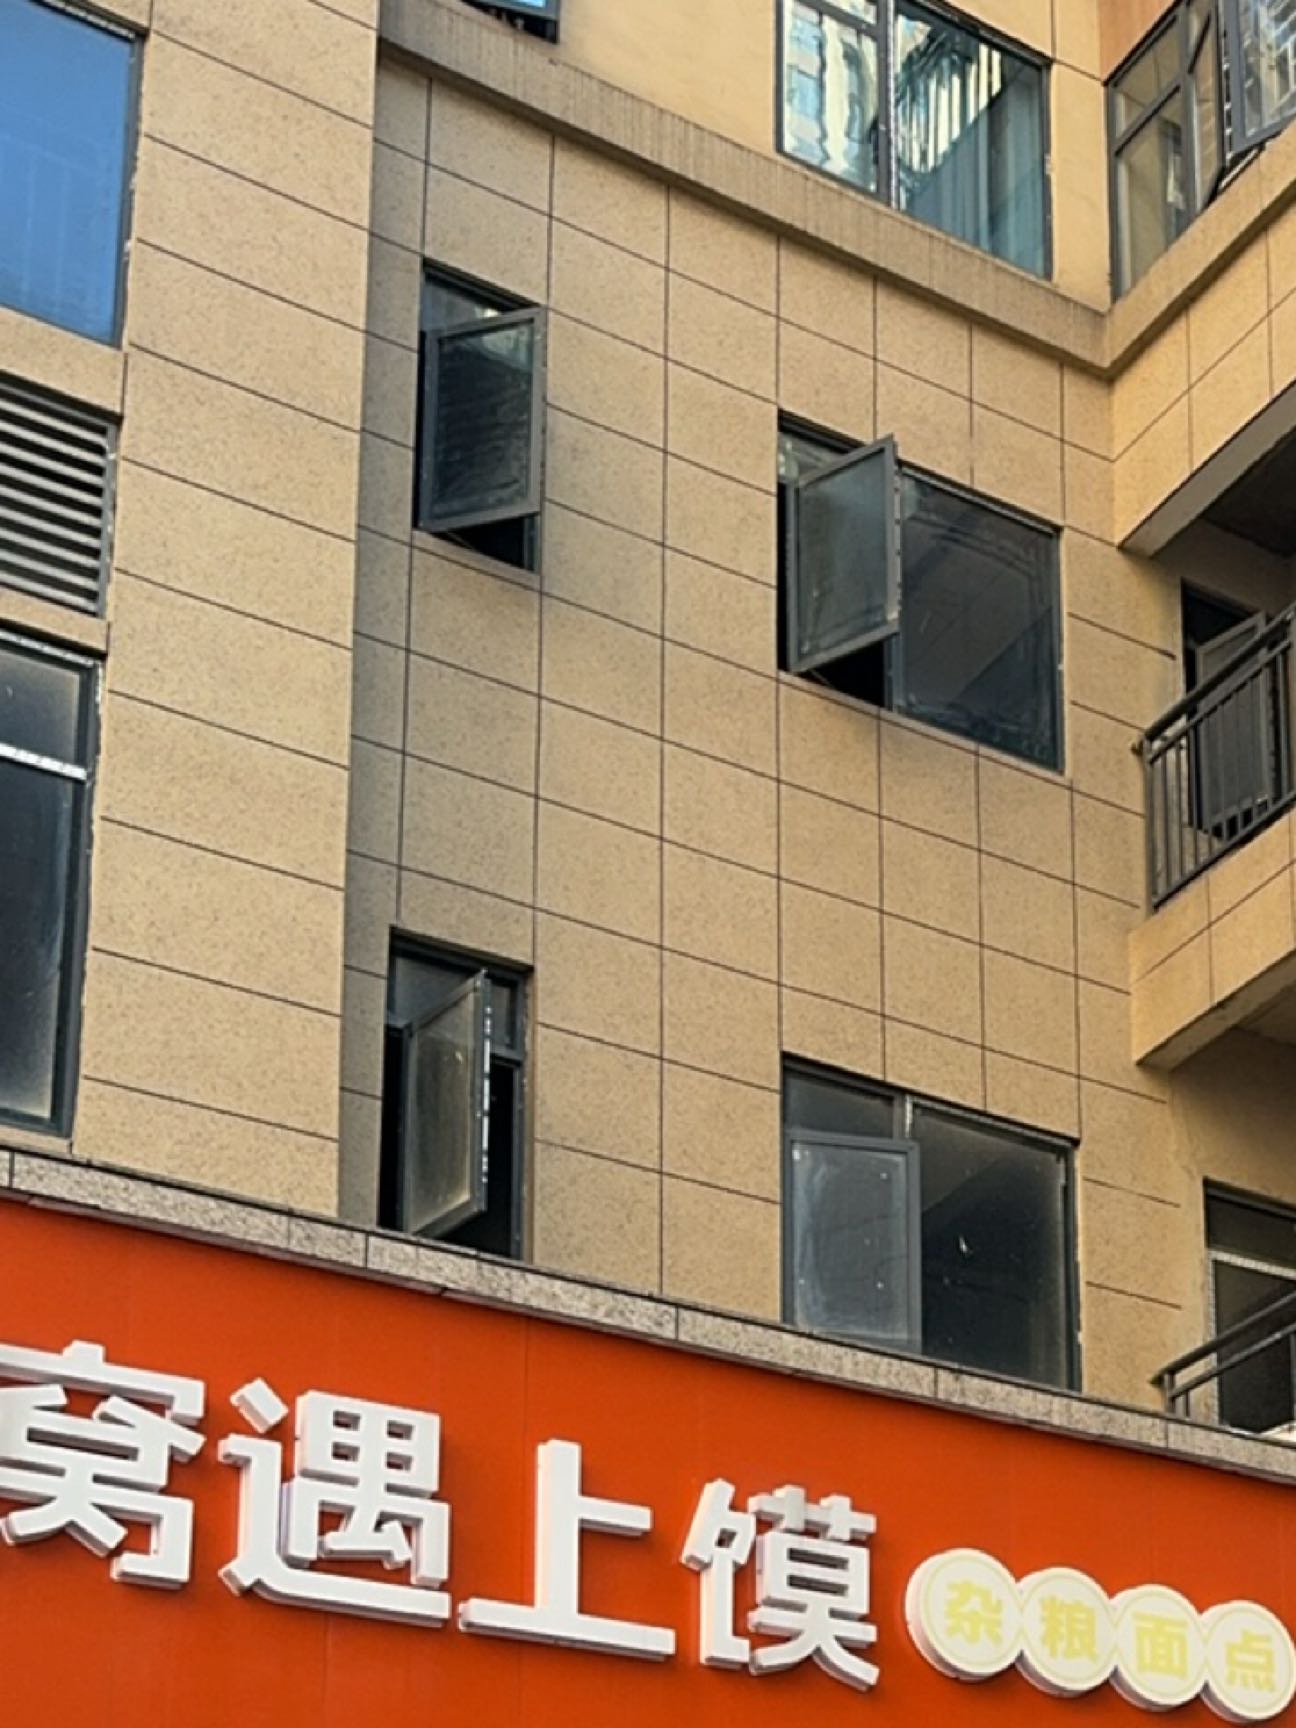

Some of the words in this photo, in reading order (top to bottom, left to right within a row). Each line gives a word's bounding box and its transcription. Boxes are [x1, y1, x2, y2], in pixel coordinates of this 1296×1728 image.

[0, 1340, 880, 1690] 窝遇上馍
[944, 1578, 1277, 1693] 杂粮面点
